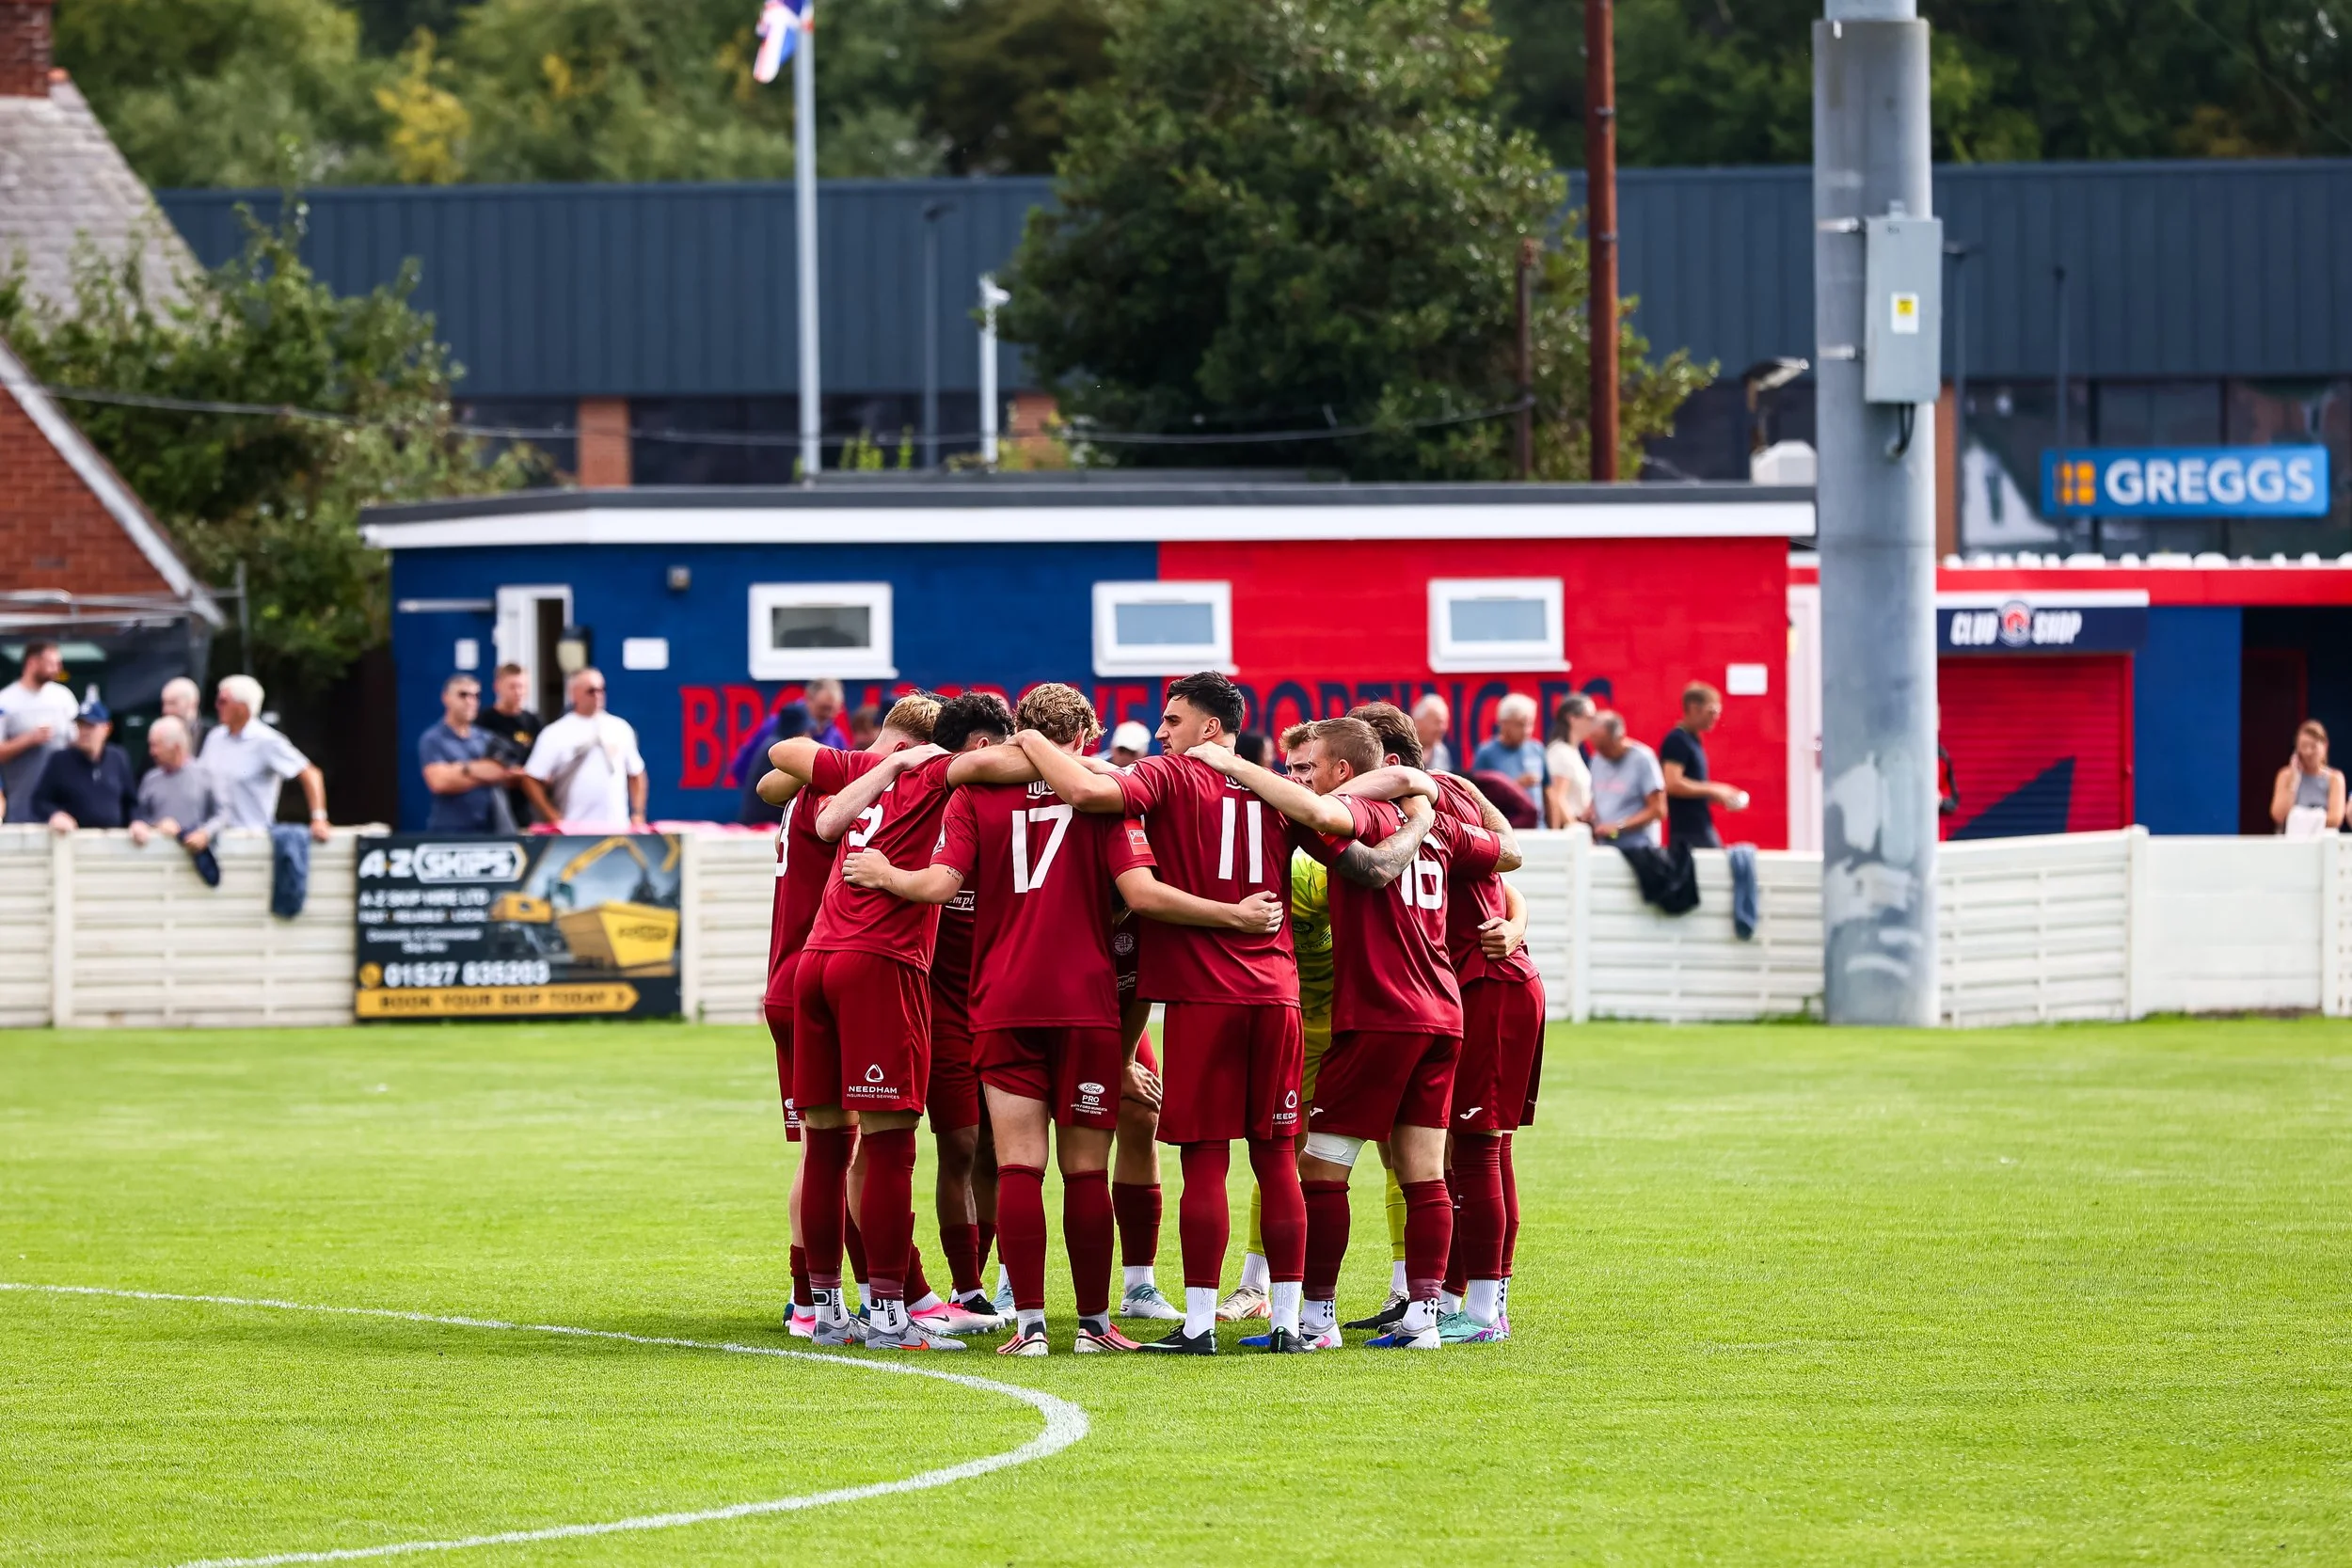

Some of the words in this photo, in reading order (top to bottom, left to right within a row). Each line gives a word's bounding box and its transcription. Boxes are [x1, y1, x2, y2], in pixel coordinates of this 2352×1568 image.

[2104, 458, 2315, 505] GREGGS
[1950, 611, 1999, 646] CLUB
[2031, 610, 2083, 645] SHOP
[1011, 803, 1073, 894] 17
[1217, 796, 1263, 884] 11
[422, 850, 512, 879] SKIPS
[1395, 825, 1444, 911] 16
[384, 961, 459, 988] 01527
[380, 995, 432, 1008] BOOK
[442, 994, 492, 1007] YOUR
[501, 993, 542, 1006] SKIP
[549, 991, 608, 1006] TODAY
[849, 1085, 898, 1094] NEEDHAM
[1084, 1084, 1101, 1092] Ford
